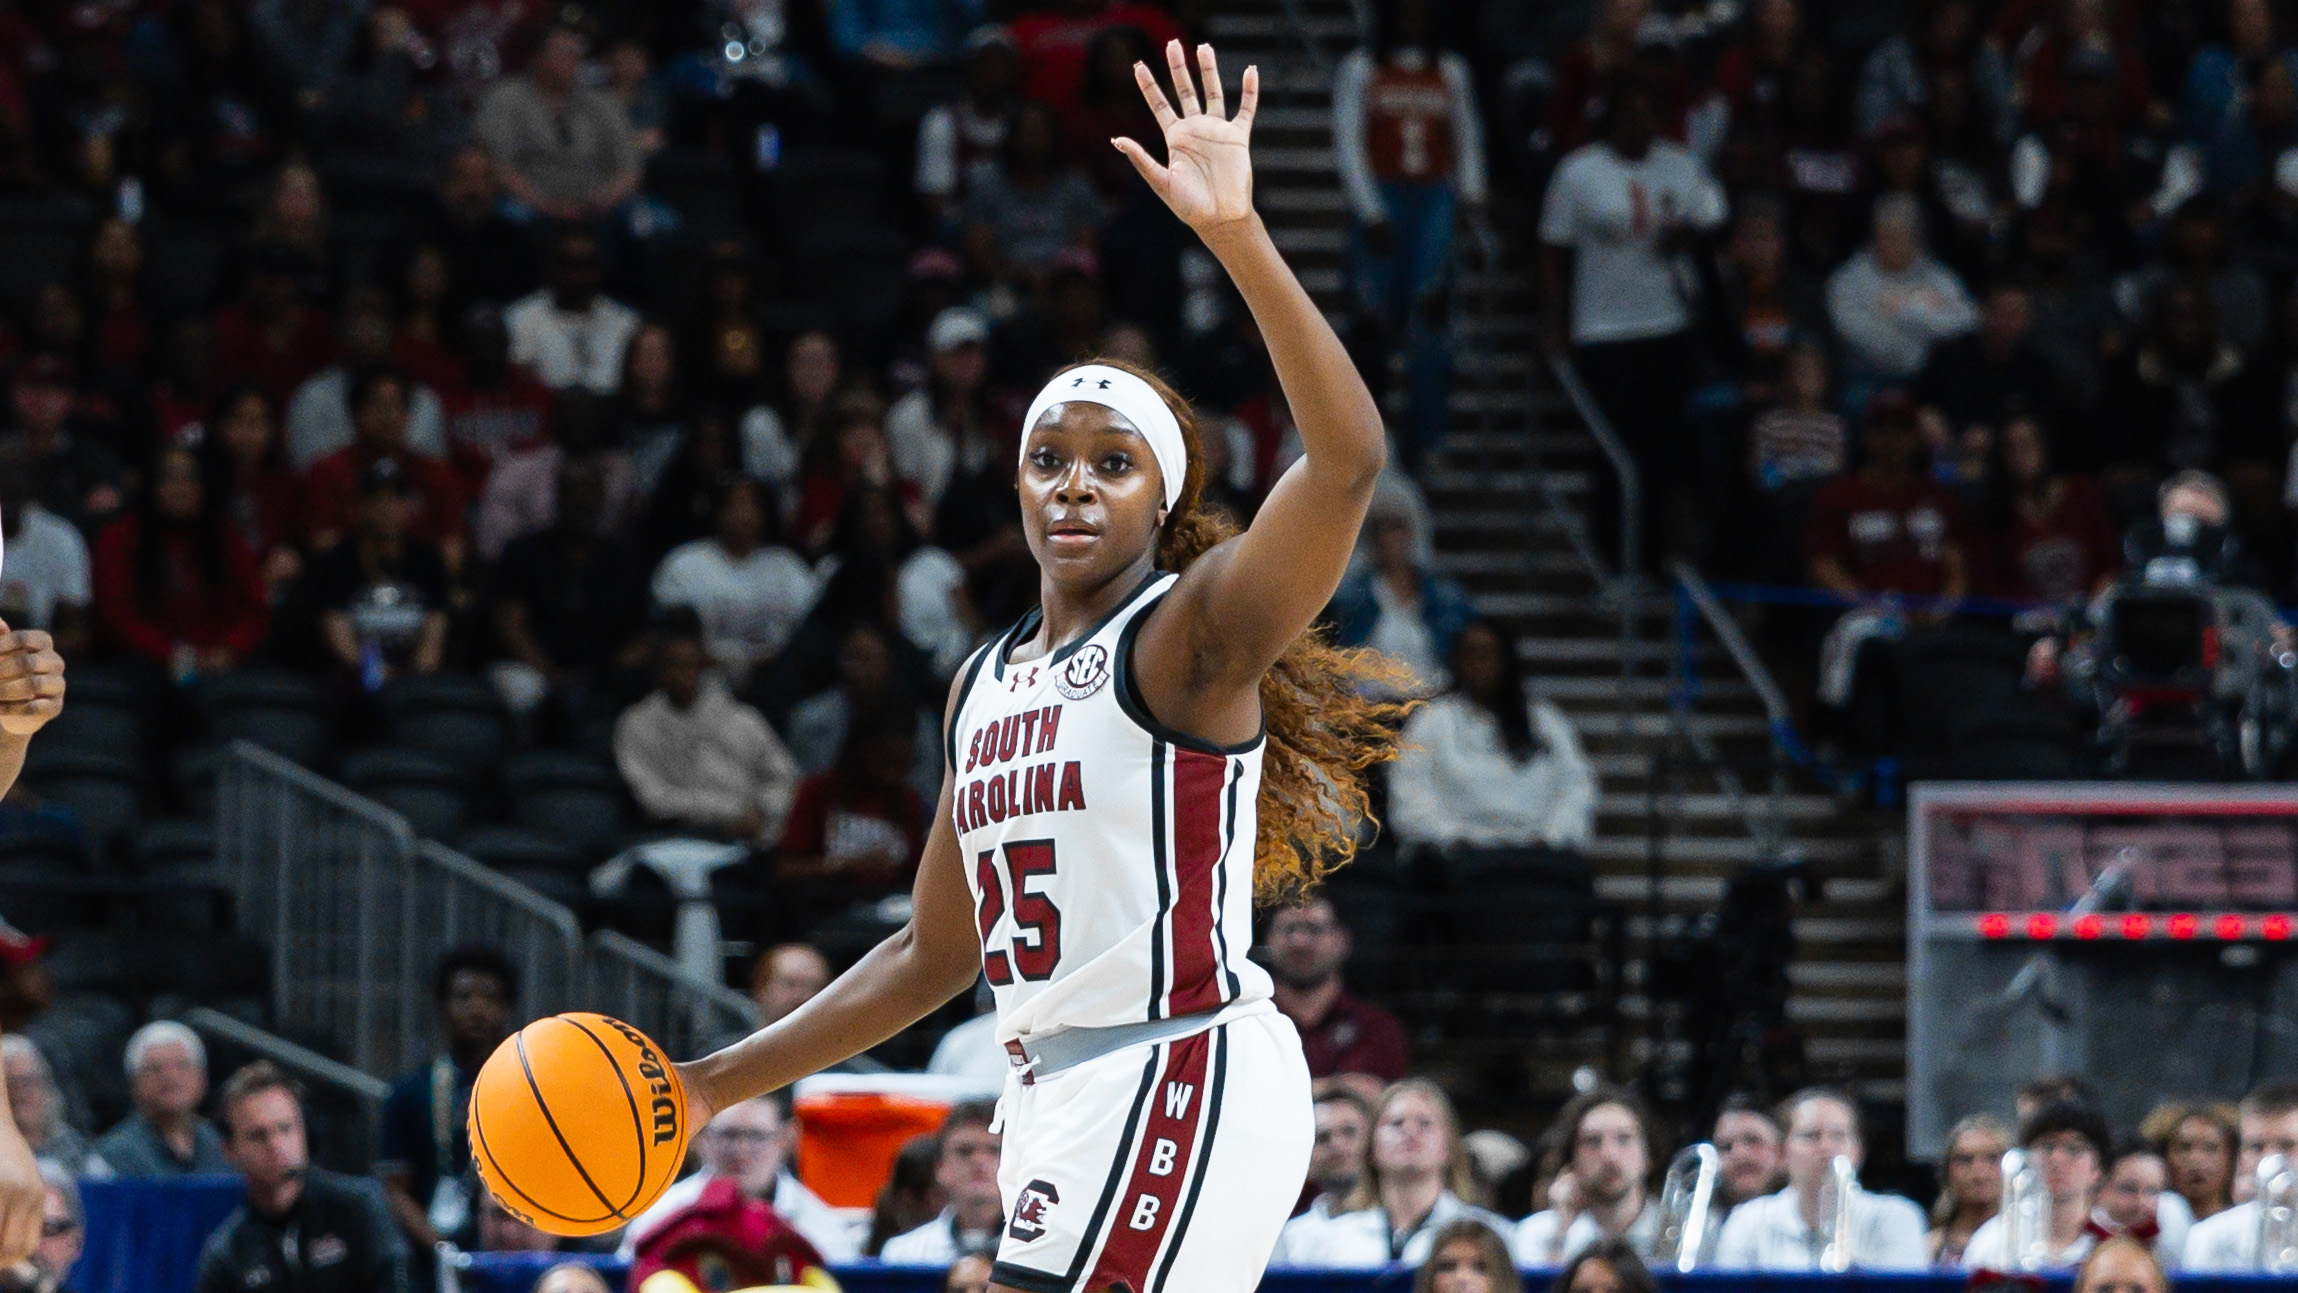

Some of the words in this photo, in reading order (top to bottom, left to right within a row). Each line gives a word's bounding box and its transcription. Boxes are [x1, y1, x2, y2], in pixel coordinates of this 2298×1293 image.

[1057, 681, 1100, 699] GRADUATE
[1069, 646, 1105, 685] SEC
[965, 704, 1063, 774] SOUTH
[956, 761, 1087, 838] AROLINA
[976, 838, 1062, 987] 25
[602, 1017, 677, 1148] Wilson
